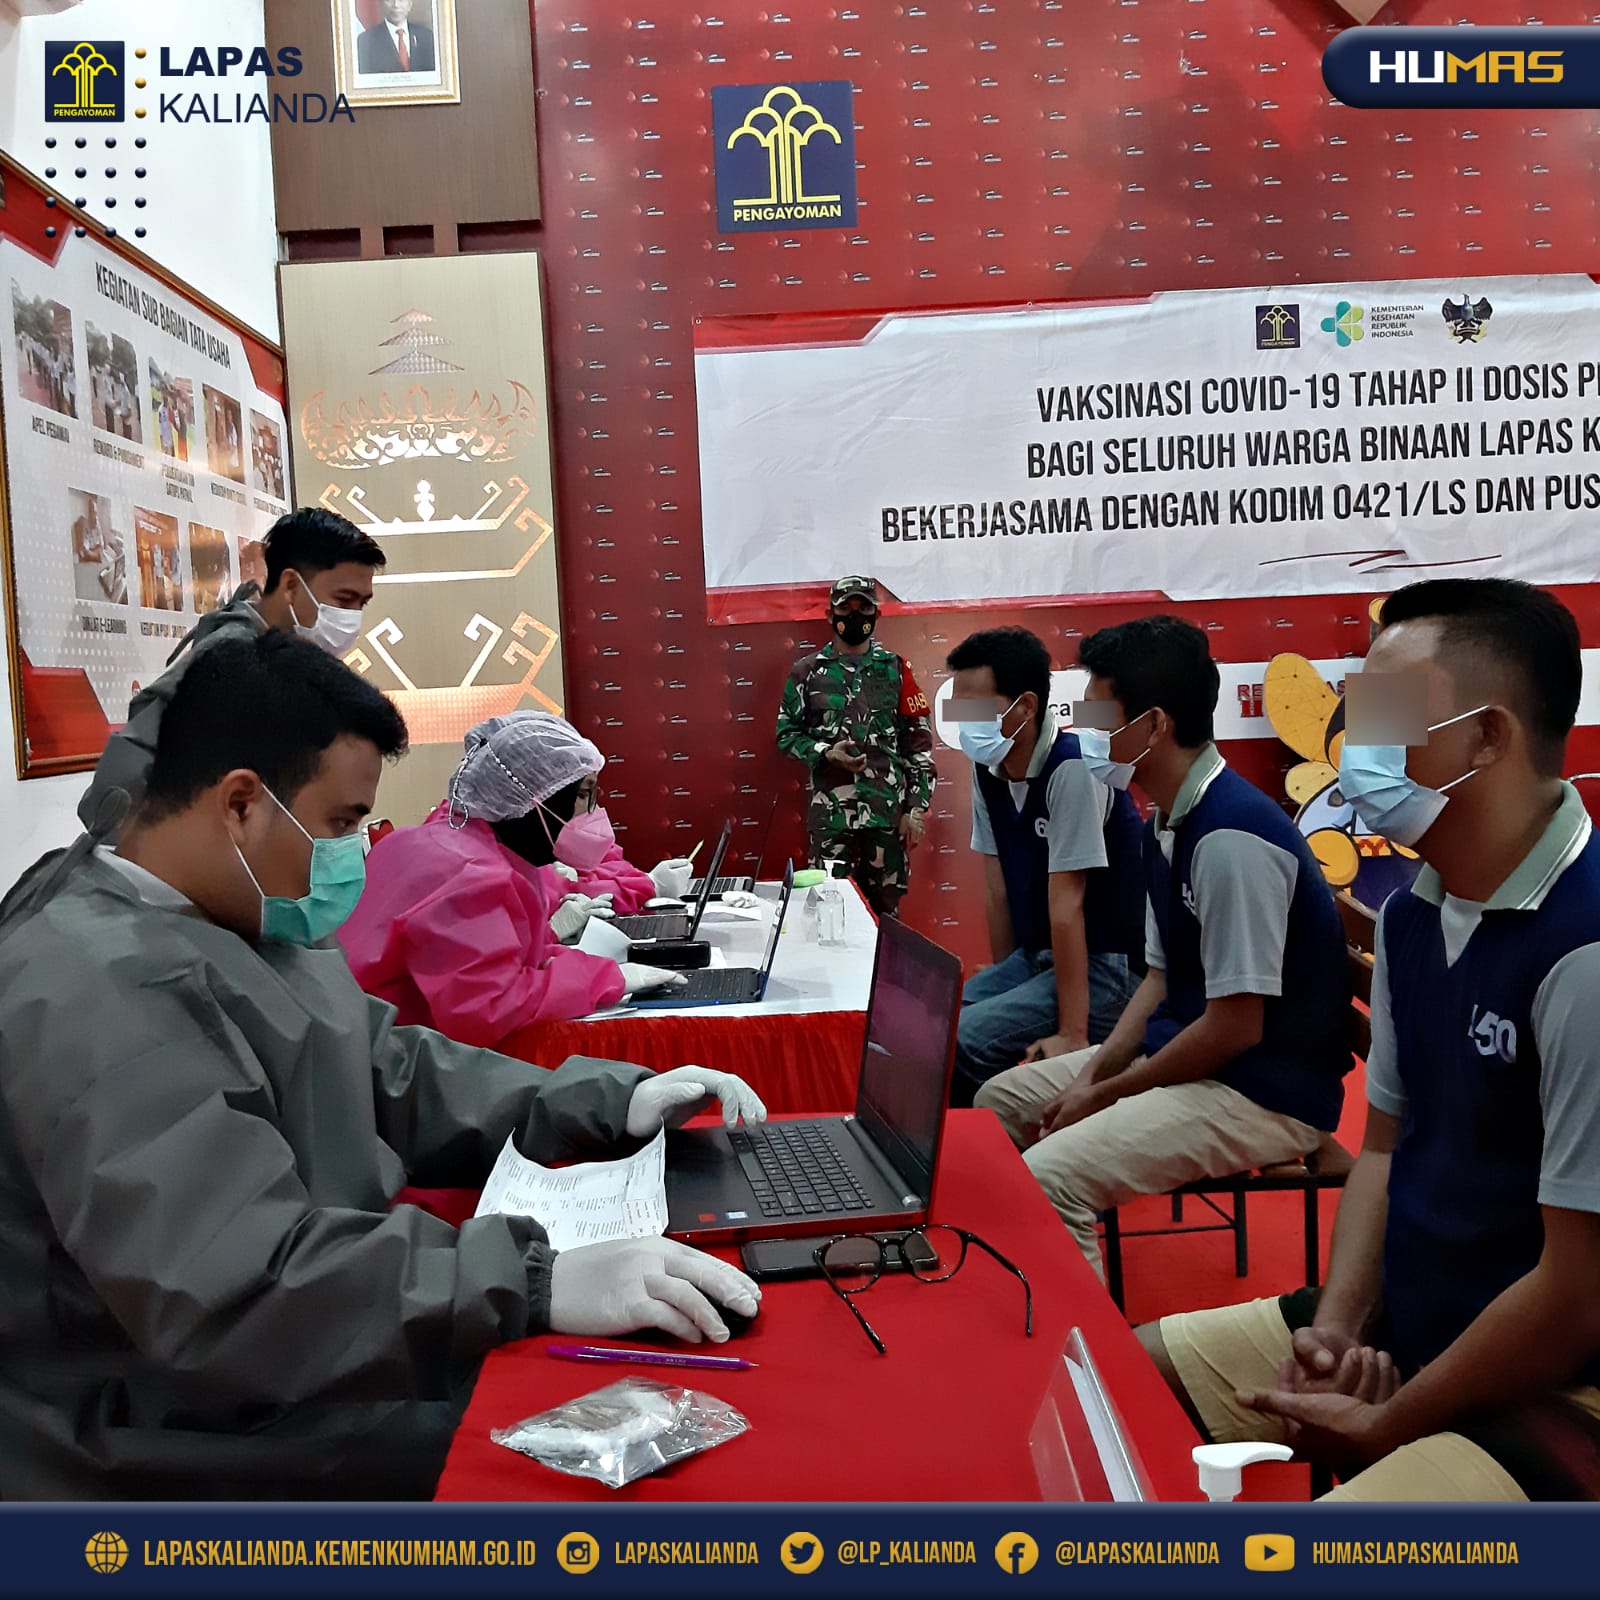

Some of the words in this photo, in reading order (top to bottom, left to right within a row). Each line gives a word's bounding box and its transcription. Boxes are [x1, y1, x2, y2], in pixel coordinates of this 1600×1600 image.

[733, 205, 842, 221] PENGAYOMAN
[95, 262, 141, 316] KEGIATAN
[141, 290, 159, 327] SUB
[159, 302, 188, 345] BAGIAN
[188, 321, 207, 356] TATA
[206, 332, 231, 370] USAHA
[1371, 313, 1415, 321] KESEHATAN
[1371, 322, 1407, 330] REPUBLIK
[1371, 330, 1414, 338] INDONESIA
[1037, 380, 1192, 423] VAKSINASI
[1201, 373, 1340, 415] COVID-19
[1350, 368, 1447, 407] TAHAP
[1456, 367, 1473, 402] II
[1483, 363, 1569, 401] DOSIS
[1578, 362, 1600, 397] P
[1027, 440, 1094, 478] BAGI
[1103, 433, 1235, 474] SELURUH
[1245, 427, 1351, 467] WARGA
[1360, 422, 1470, 462] BINAAN
[1480, 417, 1573, 457] LAPAS
[882, 497, 1093, 543] BEKERJASAMA
[1102, 490, 1219, 531] DENGAN
[1229, 485, 1324, 524] KODIM
[1333, 478, 1467, 520] 0421/LS
[1475, 476, 1535, 513] DAN
[1545, 473, 1600, 511] PUS
